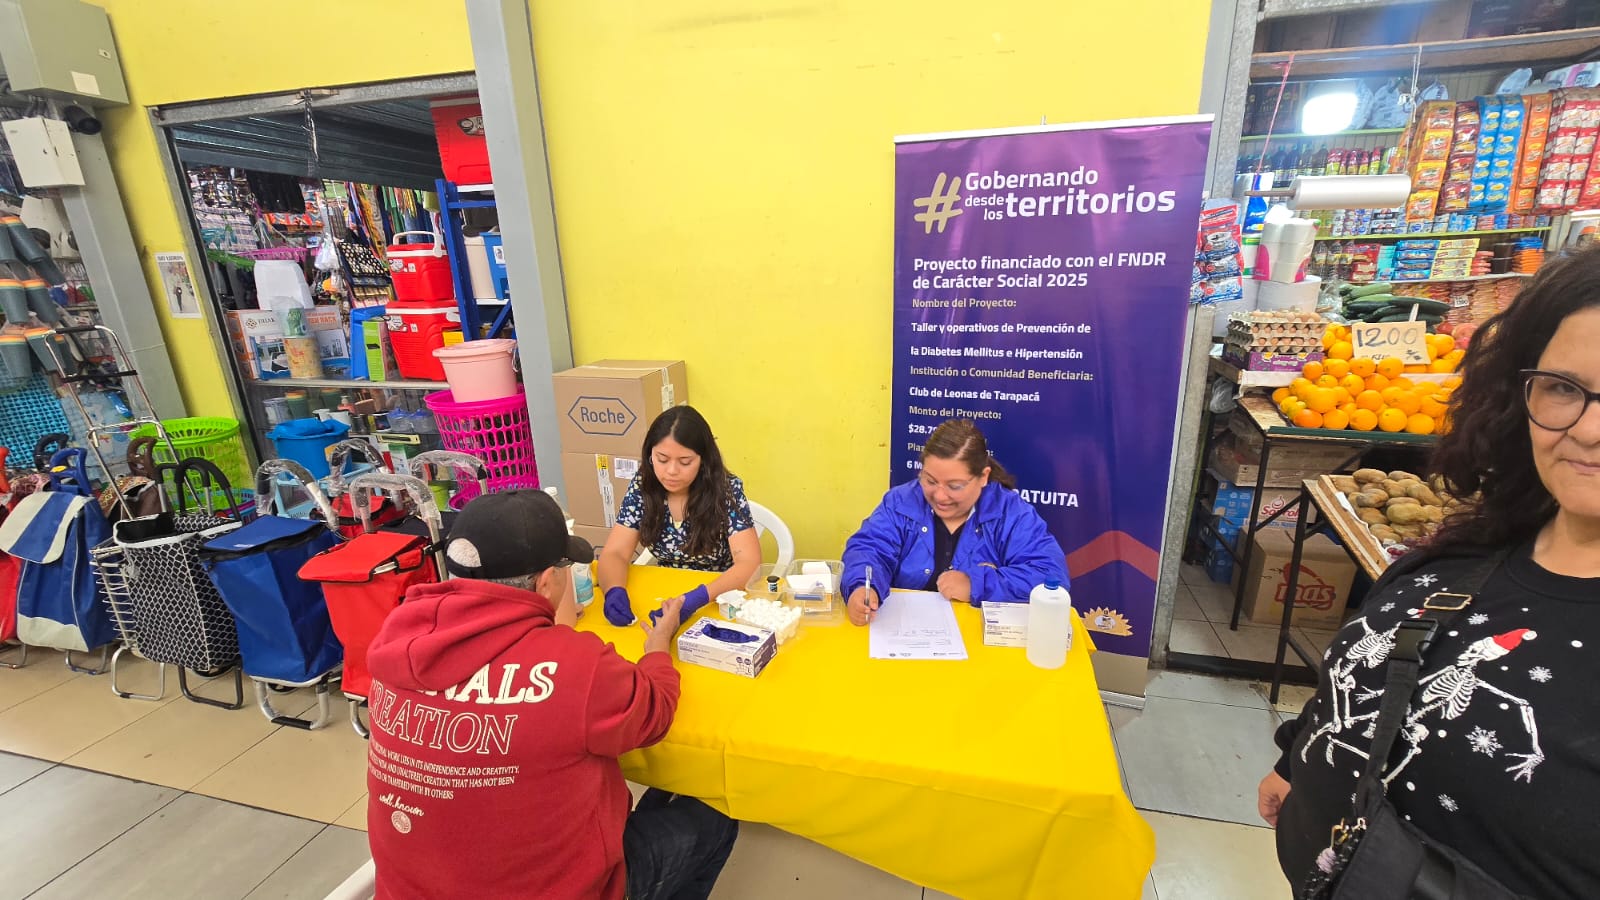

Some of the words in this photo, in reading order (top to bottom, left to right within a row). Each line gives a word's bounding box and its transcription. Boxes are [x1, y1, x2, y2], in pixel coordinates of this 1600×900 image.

[966, 166, 1098, 191] Gobernando
[965, 194, 1004, 206] desde
[1006, 185, 1175, 217] territorios
[984, 208, 1003, 220] los
[915, 257, 977, 273] Proyecto
[981, 255, 1061, 269] financiado
[1066, 257, 1094, 267] con
[1099, 253, 1113, 266] el
[1118, 252, 1166, 266] FNDR
[913, 276, 929, 289] de
[934, 274, 993, 288] Carácter
[997, 274, 1042, 287] Social
[1047, 273, 1087, 286] 2025
[913, 299, 949, 307] Nombre
[952, 298, 966, 307] del
[970, 298, 1016, 309] Proyecto:
[911, 323, 937, 331] Taller
[939, 325, 945, 333] y
[947, 323, 999, 334] operativos
[1001, 323, 1014, 332] de
[1017, 323, 1074, 333] Prevención
[1077, 324, 1090, 333] de
[1357, 328, 1418, 347] 1200
[911, 346, 919, 355] la
[921, 347, 961, 356] Diabetes
[964, 348, 1004, 357] Mellitus
[1015, 349, 1082, 360] Hipertensión
[911, 366, 958, 376] Institución
[970, 368, 1025, 378] Comunidad
[1028, 370, 1093, 380] Beneficiaria:
[910, 387, 929, 396] Club
[931, 388, 942, 397] de
[944, 389, 978, 398] Leonas
[980, 390, 992, 399] de
[994, 391, 1039, 403] Tarapacá
[580, 406, 625, 424] Roche
[909, 406, 937, 416] Monto
[940, 408, 954, 416] del
[957, 409, 1001, 420] Proyecto:
[906, 461, 913, 469] 6
[914, 461, 923, 470] M
[1012, 488, 1079, 508] ATUITA
[400, 755, 410, 766] LIES
[410, 757, 416, 767] IN
[416, 760, 424, 770] ITS
[424, 761, 467, 776] INDEPENDENCE
[467, 767, 482, 776] AND
[482, 765, 520, 776] CREATIVITY.
[387, 763, 397, 774] AND
[423, 774, 452, 788] CREATION
[452, 778, 468, 788] THAT
[469, 778, 483, 788] HAS
[483, 777, 498, 787] NOT
[498, 776, 515, 786] BEEN
[410, 782, 424, 795] WITH
[431, 788, 454, 800] OTHERS
